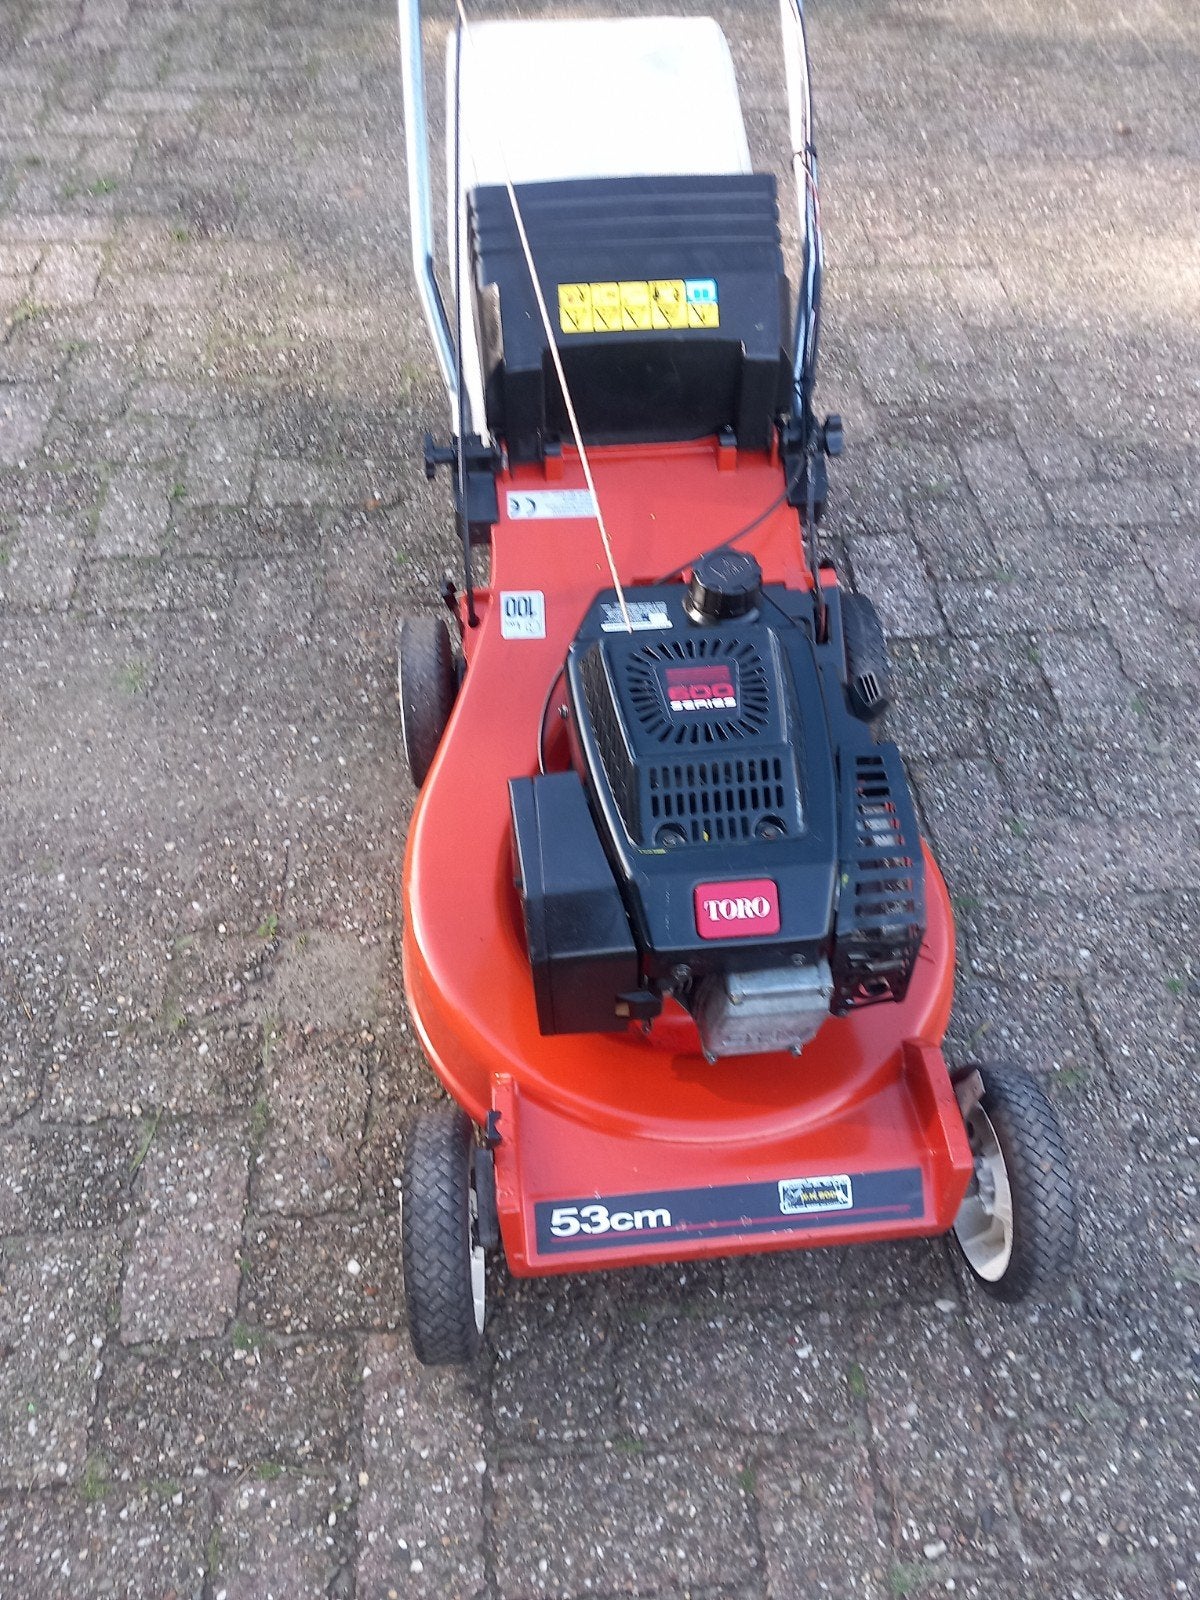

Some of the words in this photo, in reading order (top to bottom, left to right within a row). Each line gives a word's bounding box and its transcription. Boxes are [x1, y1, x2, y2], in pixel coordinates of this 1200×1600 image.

[670, 697, 737, 712] SERIES
[703, 896, 771, 922] TORO
[550, 1204, 672, 1238] 53cm
